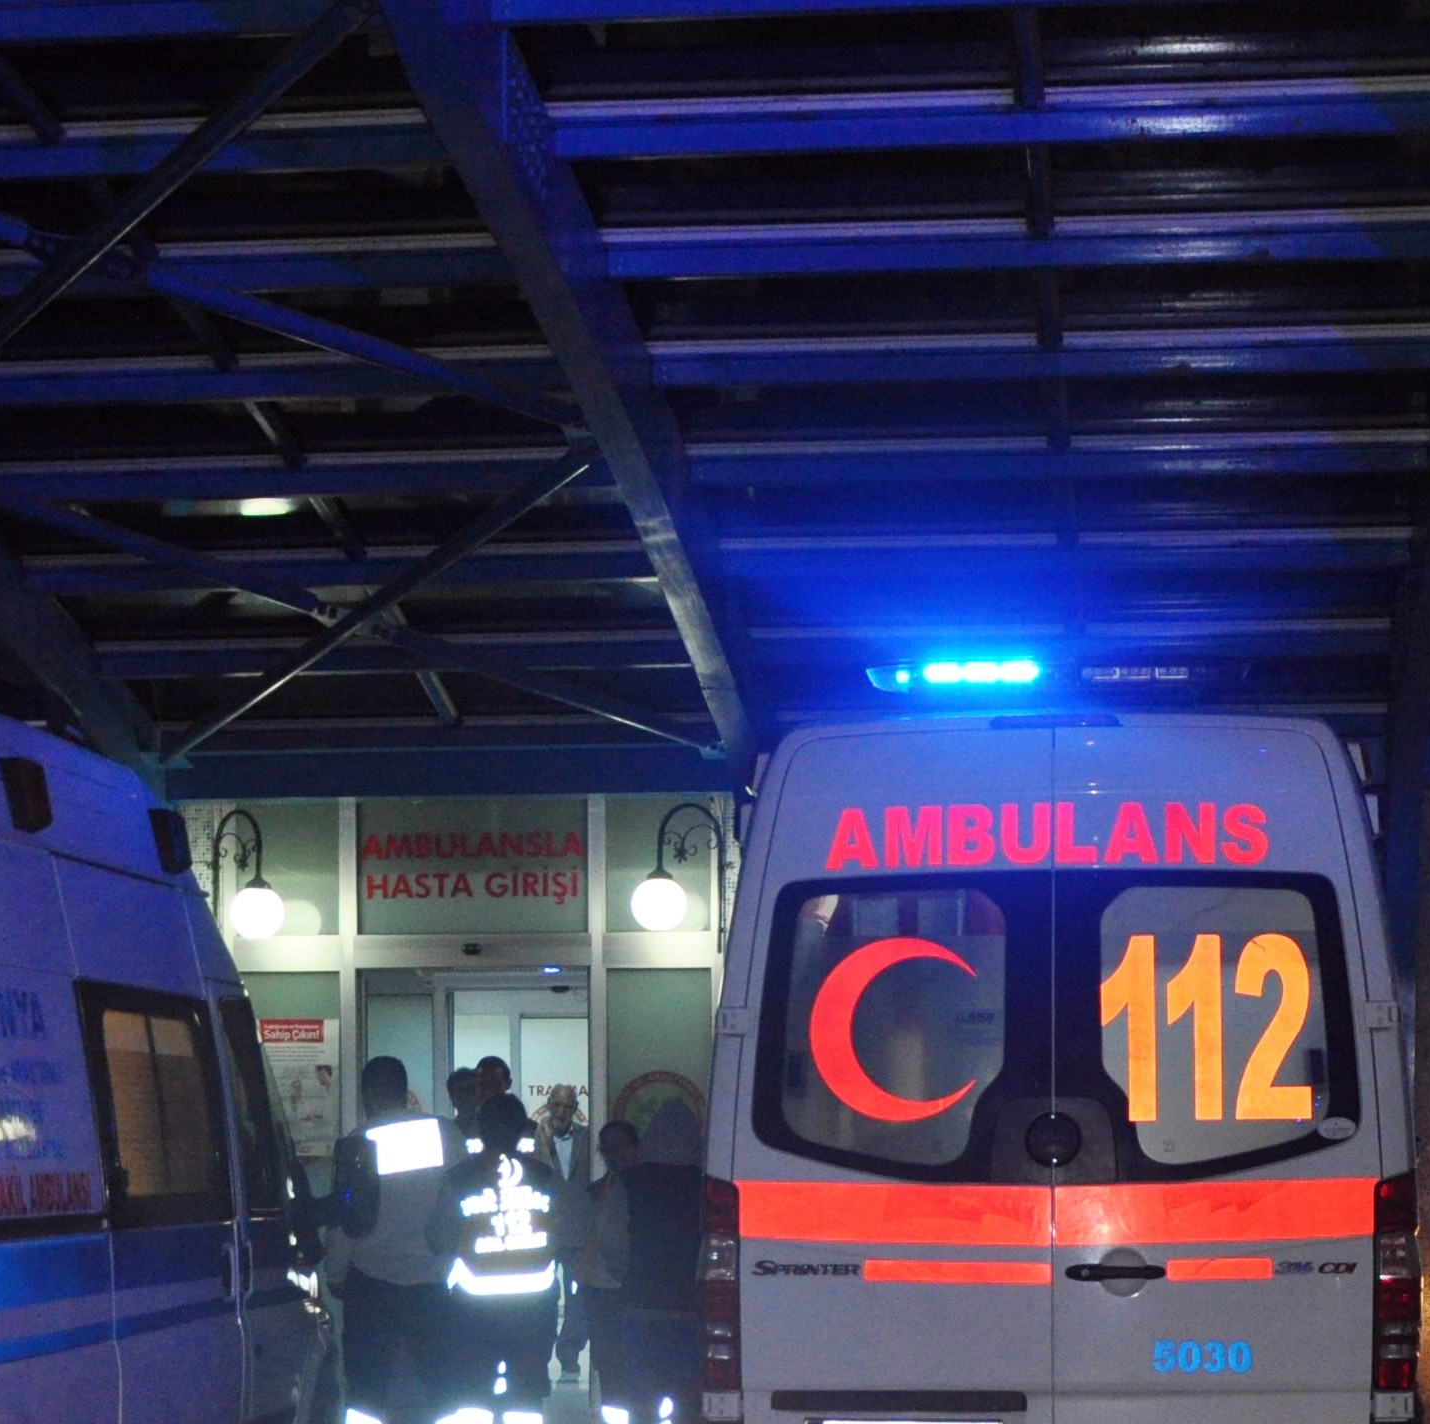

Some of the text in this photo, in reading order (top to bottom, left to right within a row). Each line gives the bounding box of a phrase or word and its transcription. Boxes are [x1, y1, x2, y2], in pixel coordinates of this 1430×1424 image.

[360, 830, 587, 860] AMBULANSLA
[825, 801, 1270, 870] AMBULANS
[365, 865, 580, 905] HASTA GİRİŞİ
[263, 1030, 291, 1041] Sahip
[1100, 931, 1314, 1123] 112
[752, 1260, 862, 1276] SPRINTER
[1318, 1262, 1358, 1274] CDI
[1153, 1340, 1253, 1374] 5030
